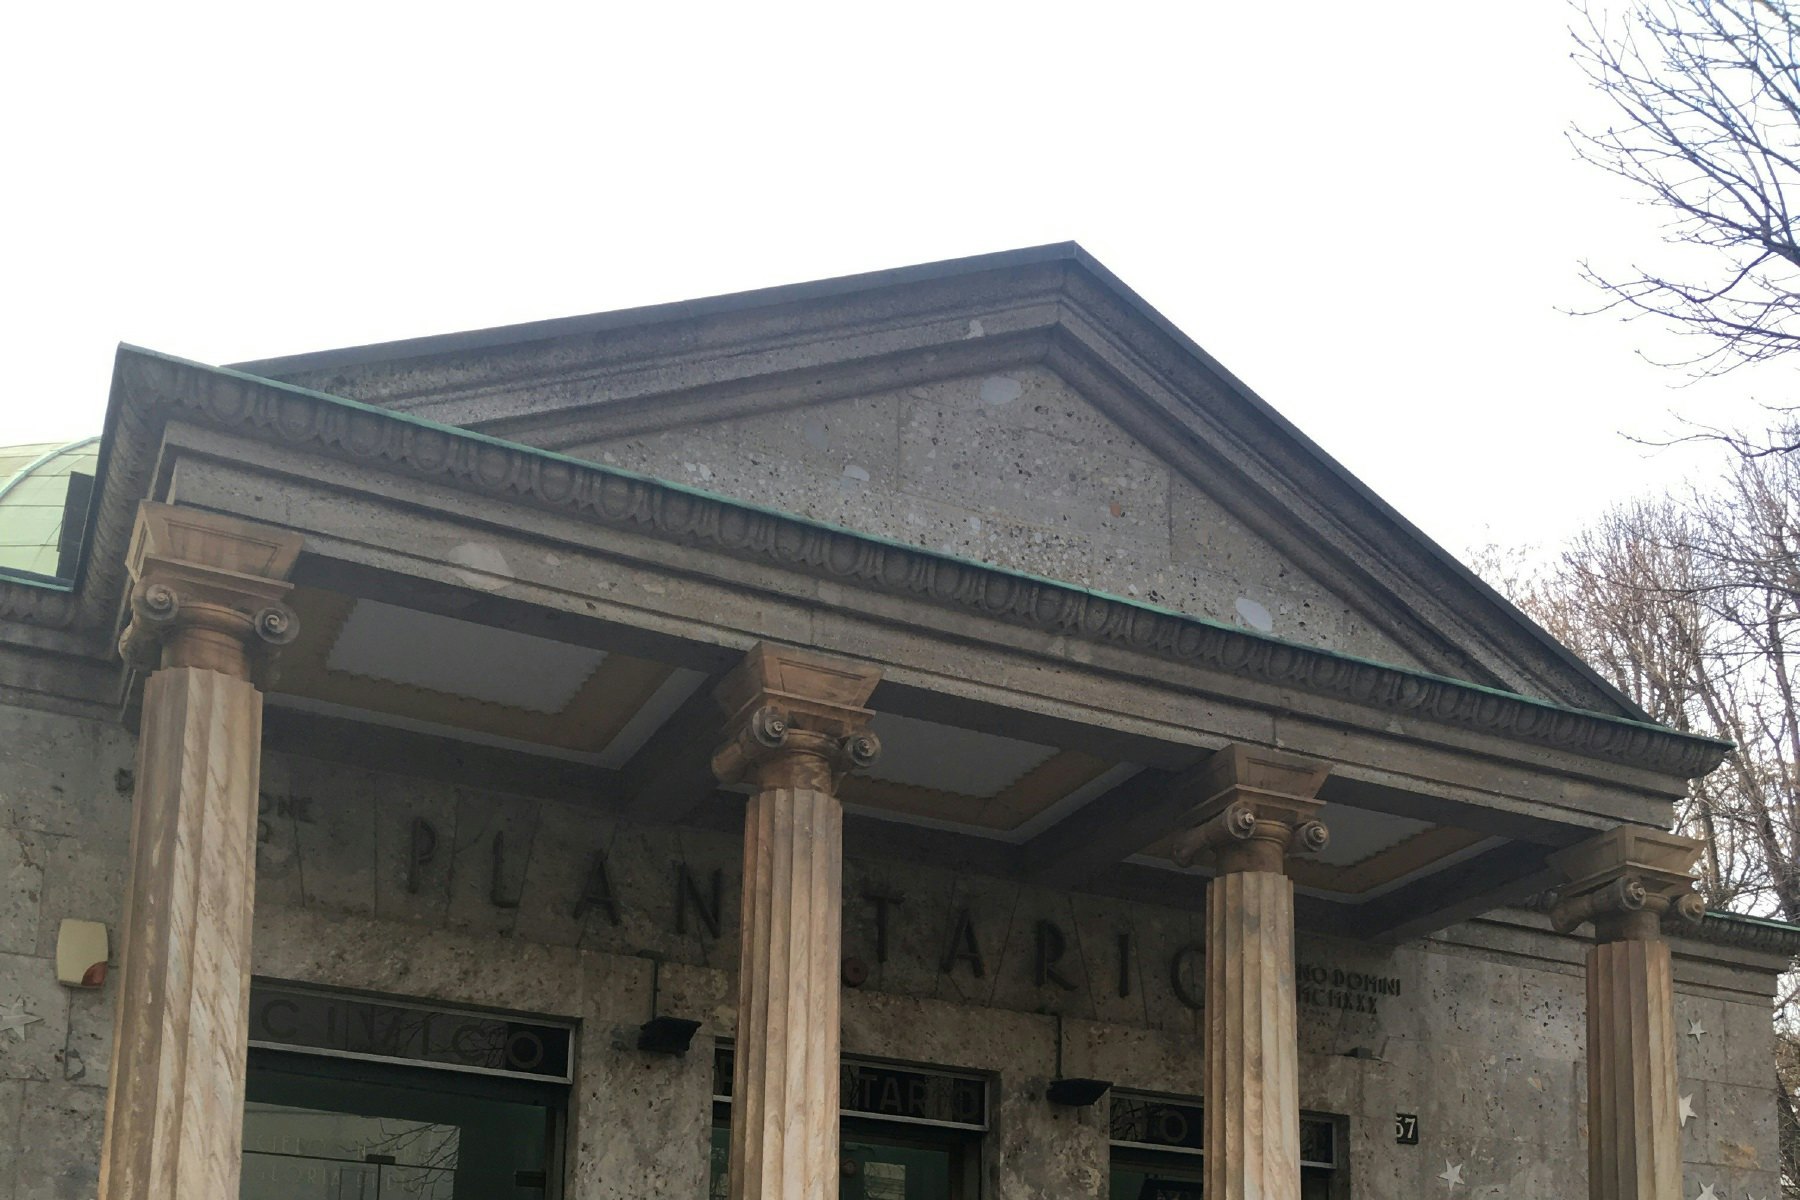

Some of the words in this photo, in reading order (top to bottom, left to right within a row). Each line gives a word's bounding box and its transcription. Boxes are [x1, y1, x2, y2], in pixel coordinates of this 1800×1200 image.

[407, 816, 1206, 1010] PLANTARIO
[1332, 969, 1400, 997] DOMINI
[260, 998, 544, 1069] CIVICO
